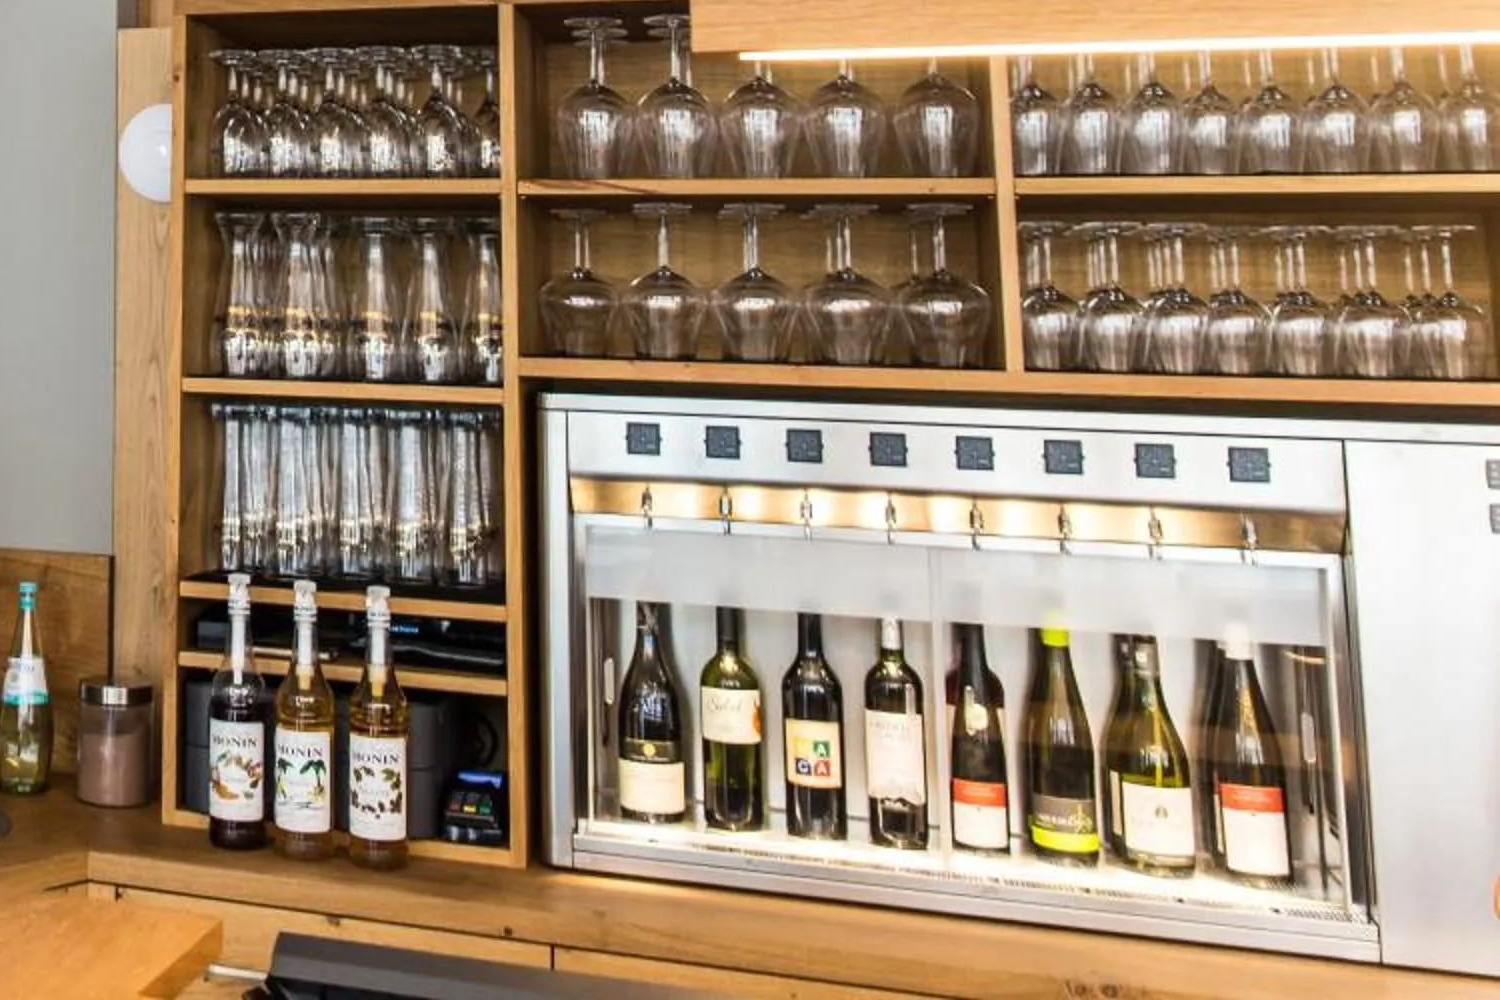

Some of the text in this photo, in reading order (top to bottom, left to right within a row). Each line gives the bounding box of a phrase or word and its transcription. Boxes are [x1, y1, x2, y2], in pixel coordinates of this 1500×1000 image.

[213, 734, 257, 749] MONIN
[277, 743, 323, 757] MONIN
[353, 751, 399, 765] MONIN
